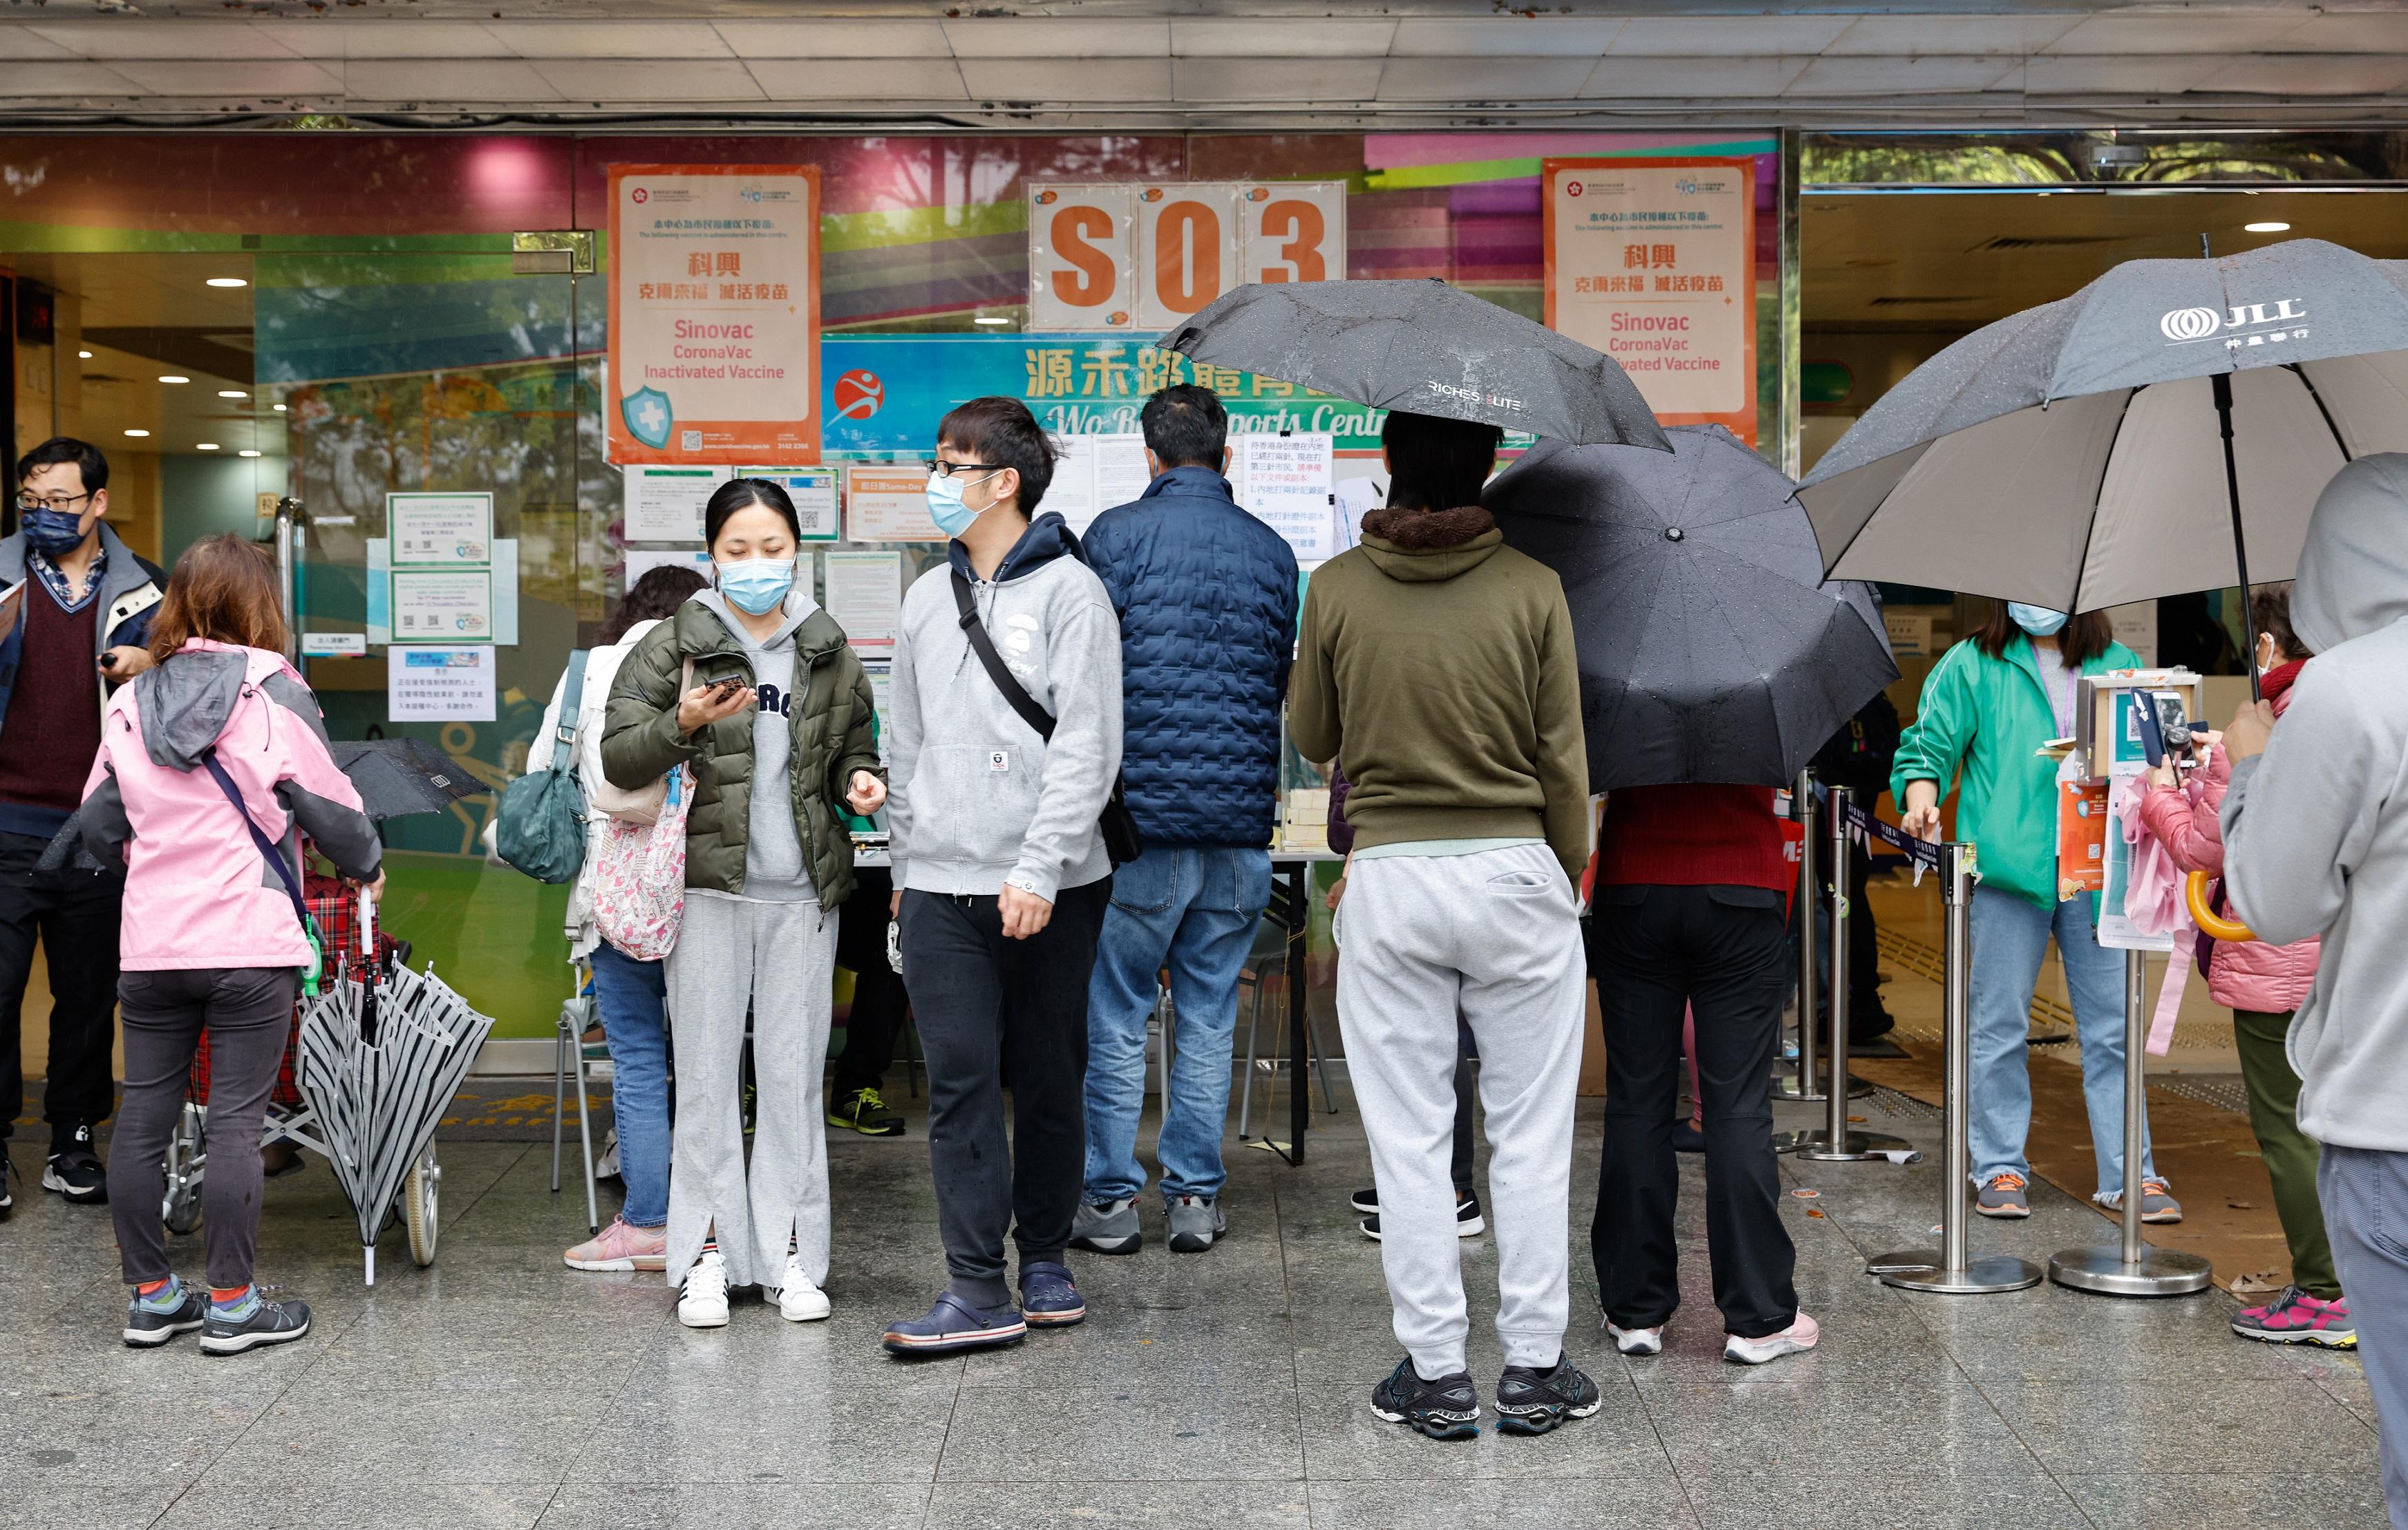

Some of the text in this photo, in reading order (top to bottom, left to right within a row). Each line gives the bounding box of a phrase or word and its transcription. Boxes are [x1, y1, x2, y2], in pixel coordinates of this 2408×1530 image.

[688, 252, 741, 277] 科興
[1624, 244, 1676, 269] 科興
[1610, 312, 1689, 331] Sinovac
[2223, 298, 2307, 328] JLL
[674, 319, 753, 339] Sinovac
[673, 345, 753, 359] CoronaVac
[1610, 337, 1689, 351] CoronaVac
[644, 365, 784, 379] Inactivated Vaccine
[1617, 357, 1720, 370] ivated Vaccine
[1427, 380, 1480, 402] RICHES
[1225, 406, 1304, 434] ports
[1311, 404, 1387, 436] Centr
[1255, 498, 1264, 507] 本
